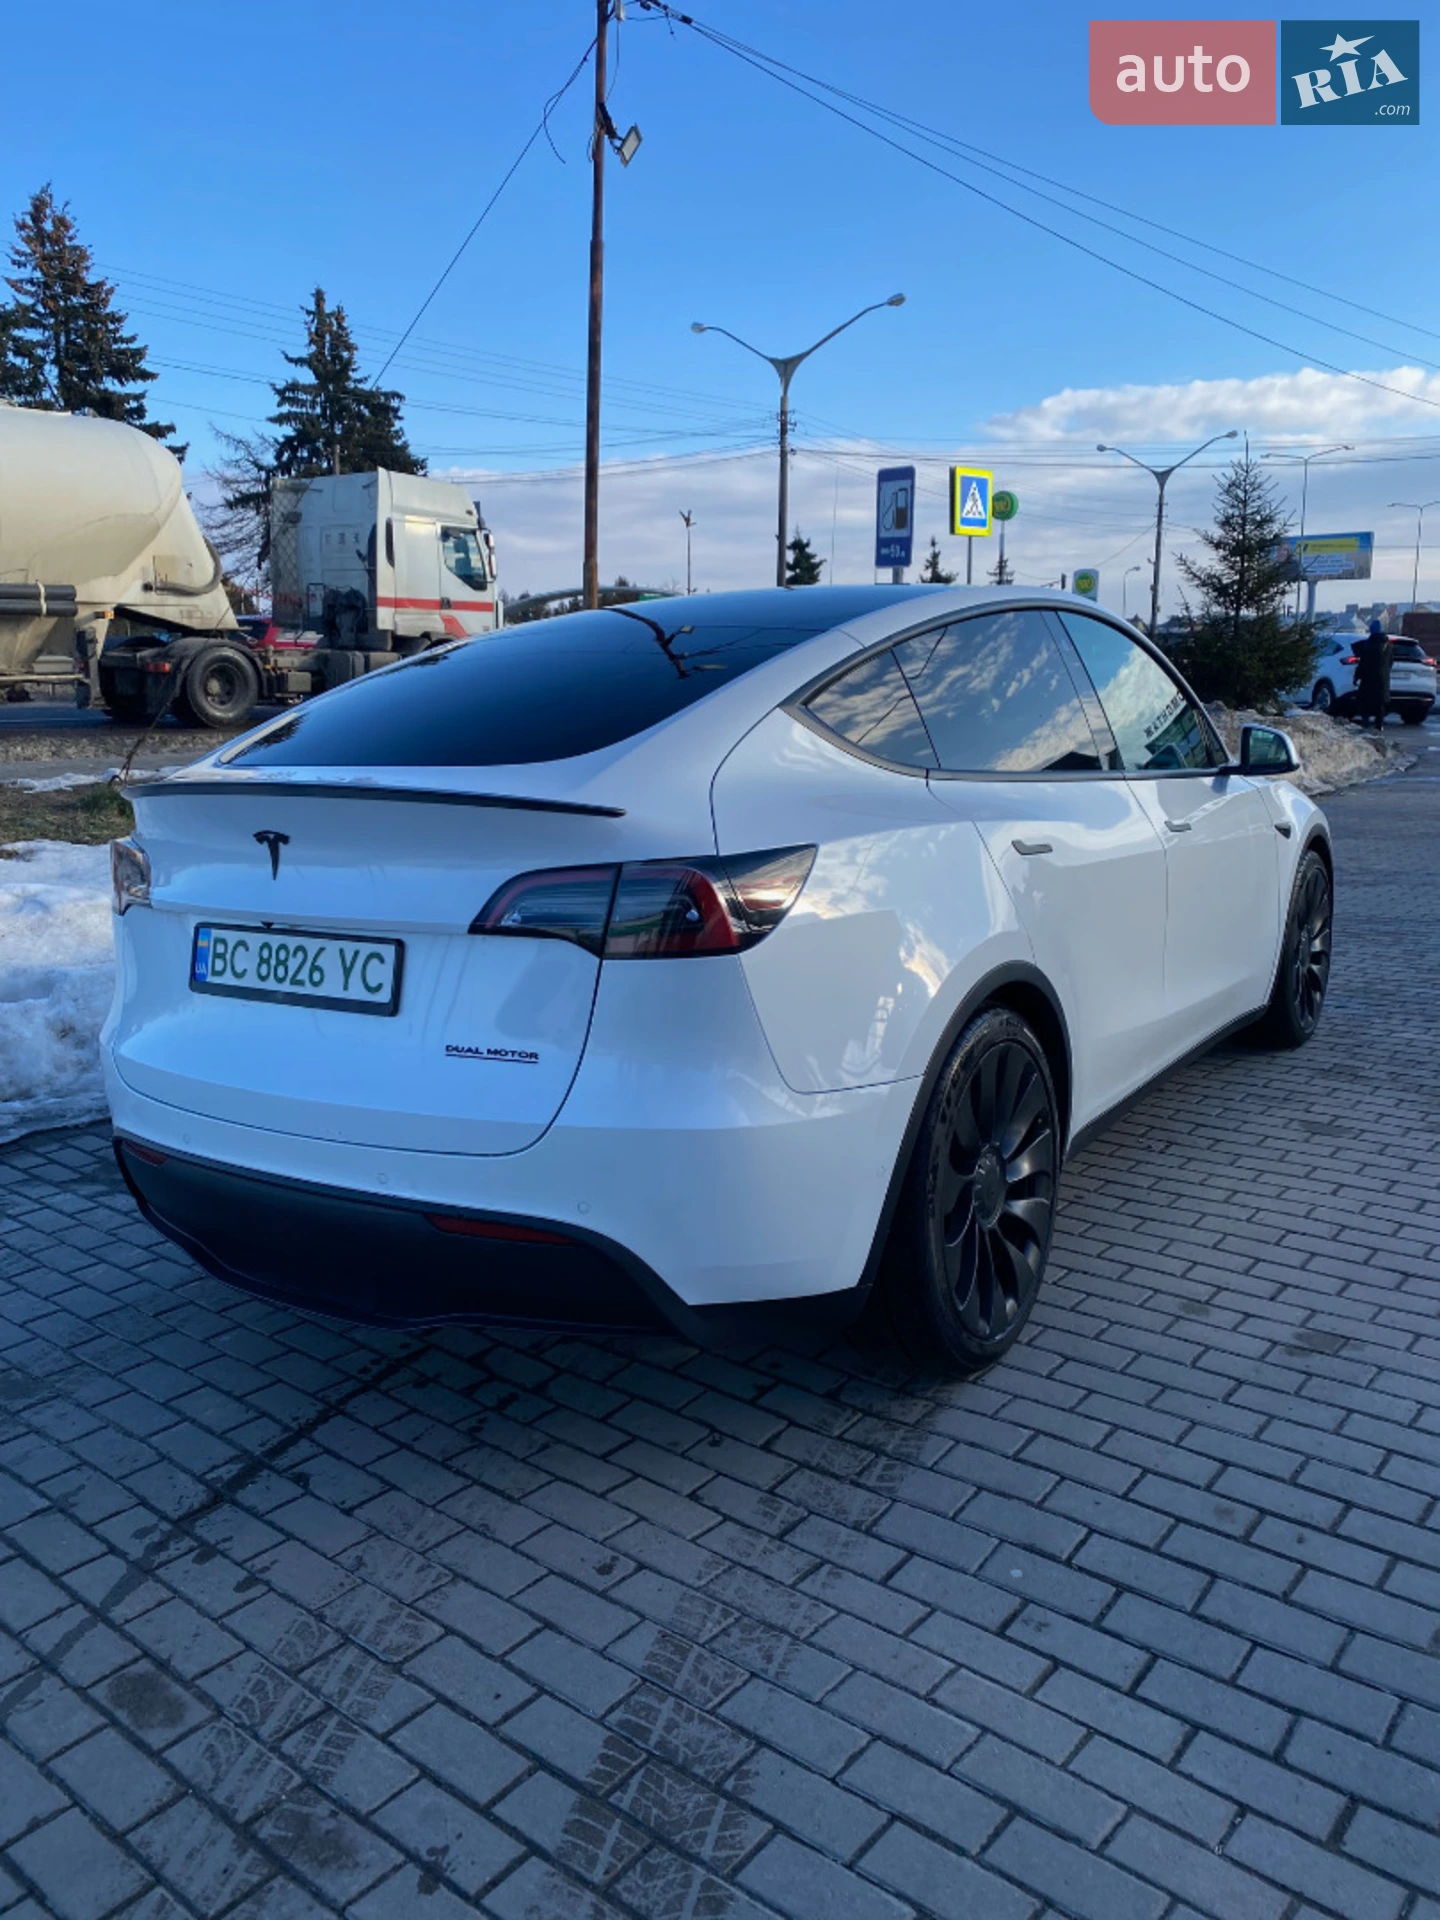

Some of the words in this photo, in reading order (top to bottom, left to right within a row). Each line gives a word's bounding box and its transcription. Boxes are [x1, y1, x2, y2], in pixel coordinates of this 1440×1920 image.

[211, 936, 249, 980] BC
[256, 941, 325, 988] 8826
[339, 947, 386, 995] YC
[445, 1044, 484, 1055] DUAL
[486, 1048, 539, 1060] MOTOR
